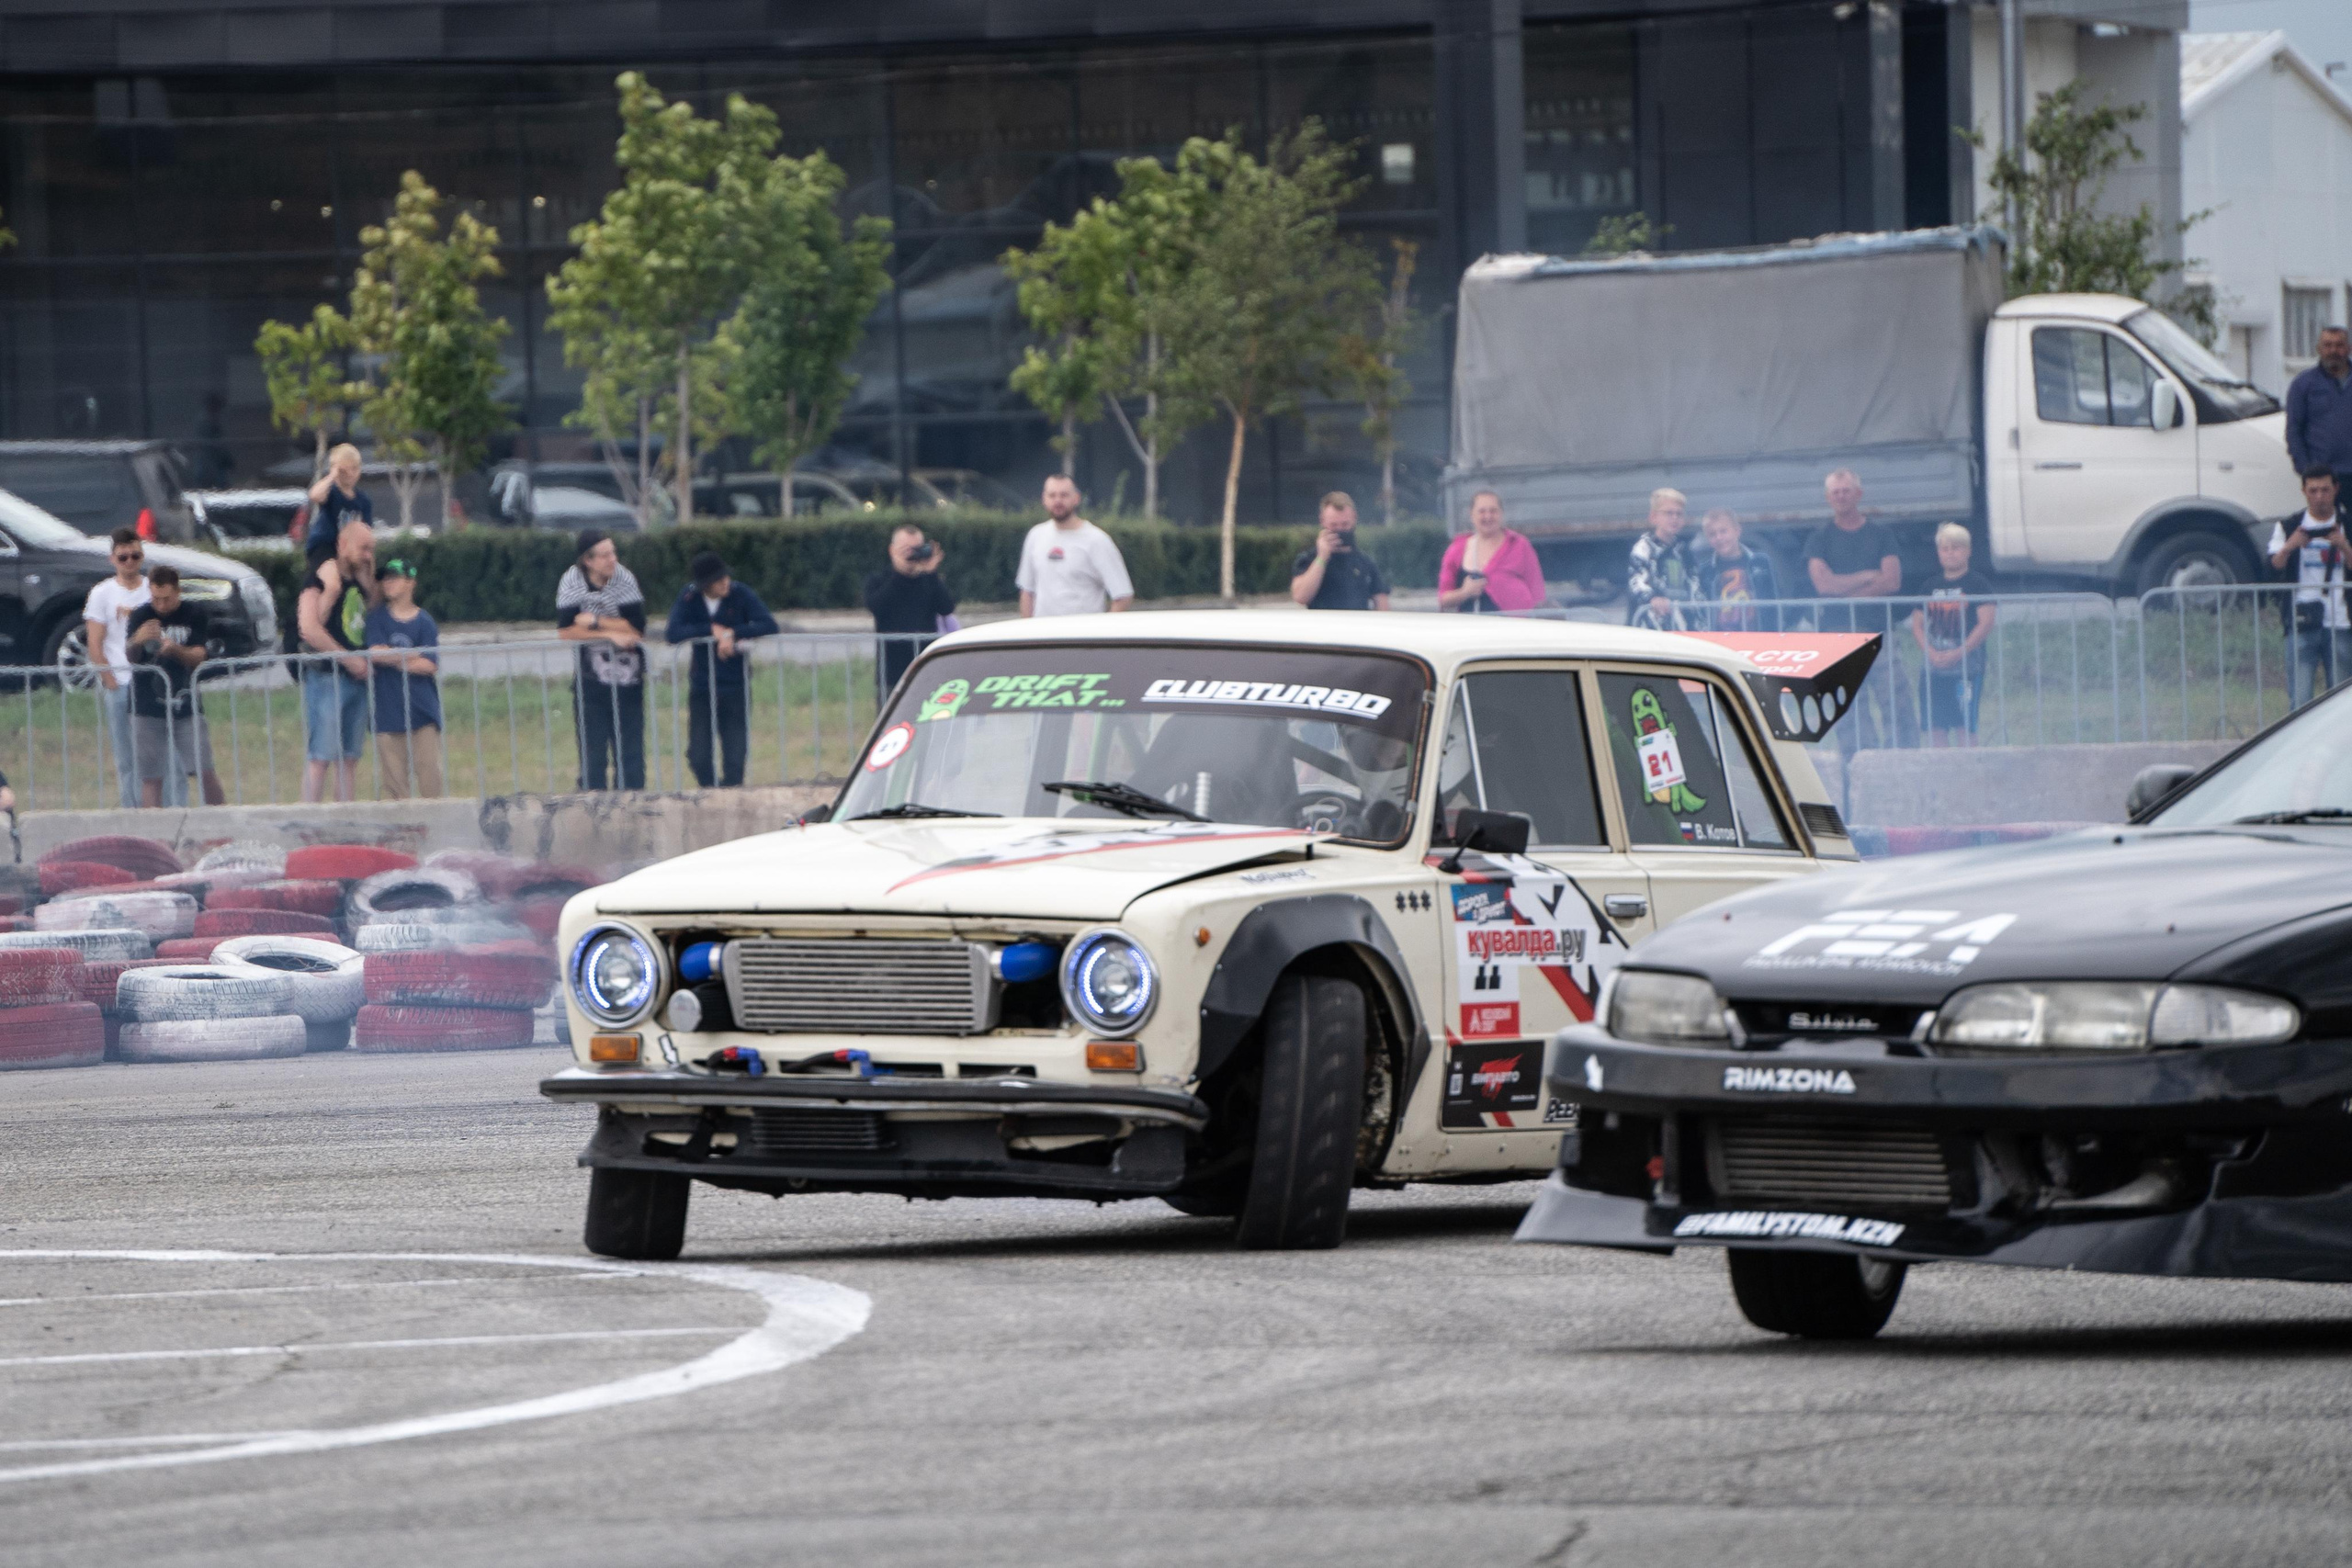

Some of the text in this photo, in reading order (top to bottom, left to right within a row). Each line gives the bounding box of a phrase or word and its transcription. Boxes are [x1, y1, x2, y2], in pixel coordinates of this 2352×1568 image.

[974, 673, 1111, 694] DRIFT
[1142, 679, 1392, 717] CLUBTURBO
[1647, 750, 1673, 777] 21
[1467, 929, 1586, 964] кувалда.ру
[1788, 1012, 1879, 1031] Silvia
[1724, 1066, 1857, 1094] RIMZONA
